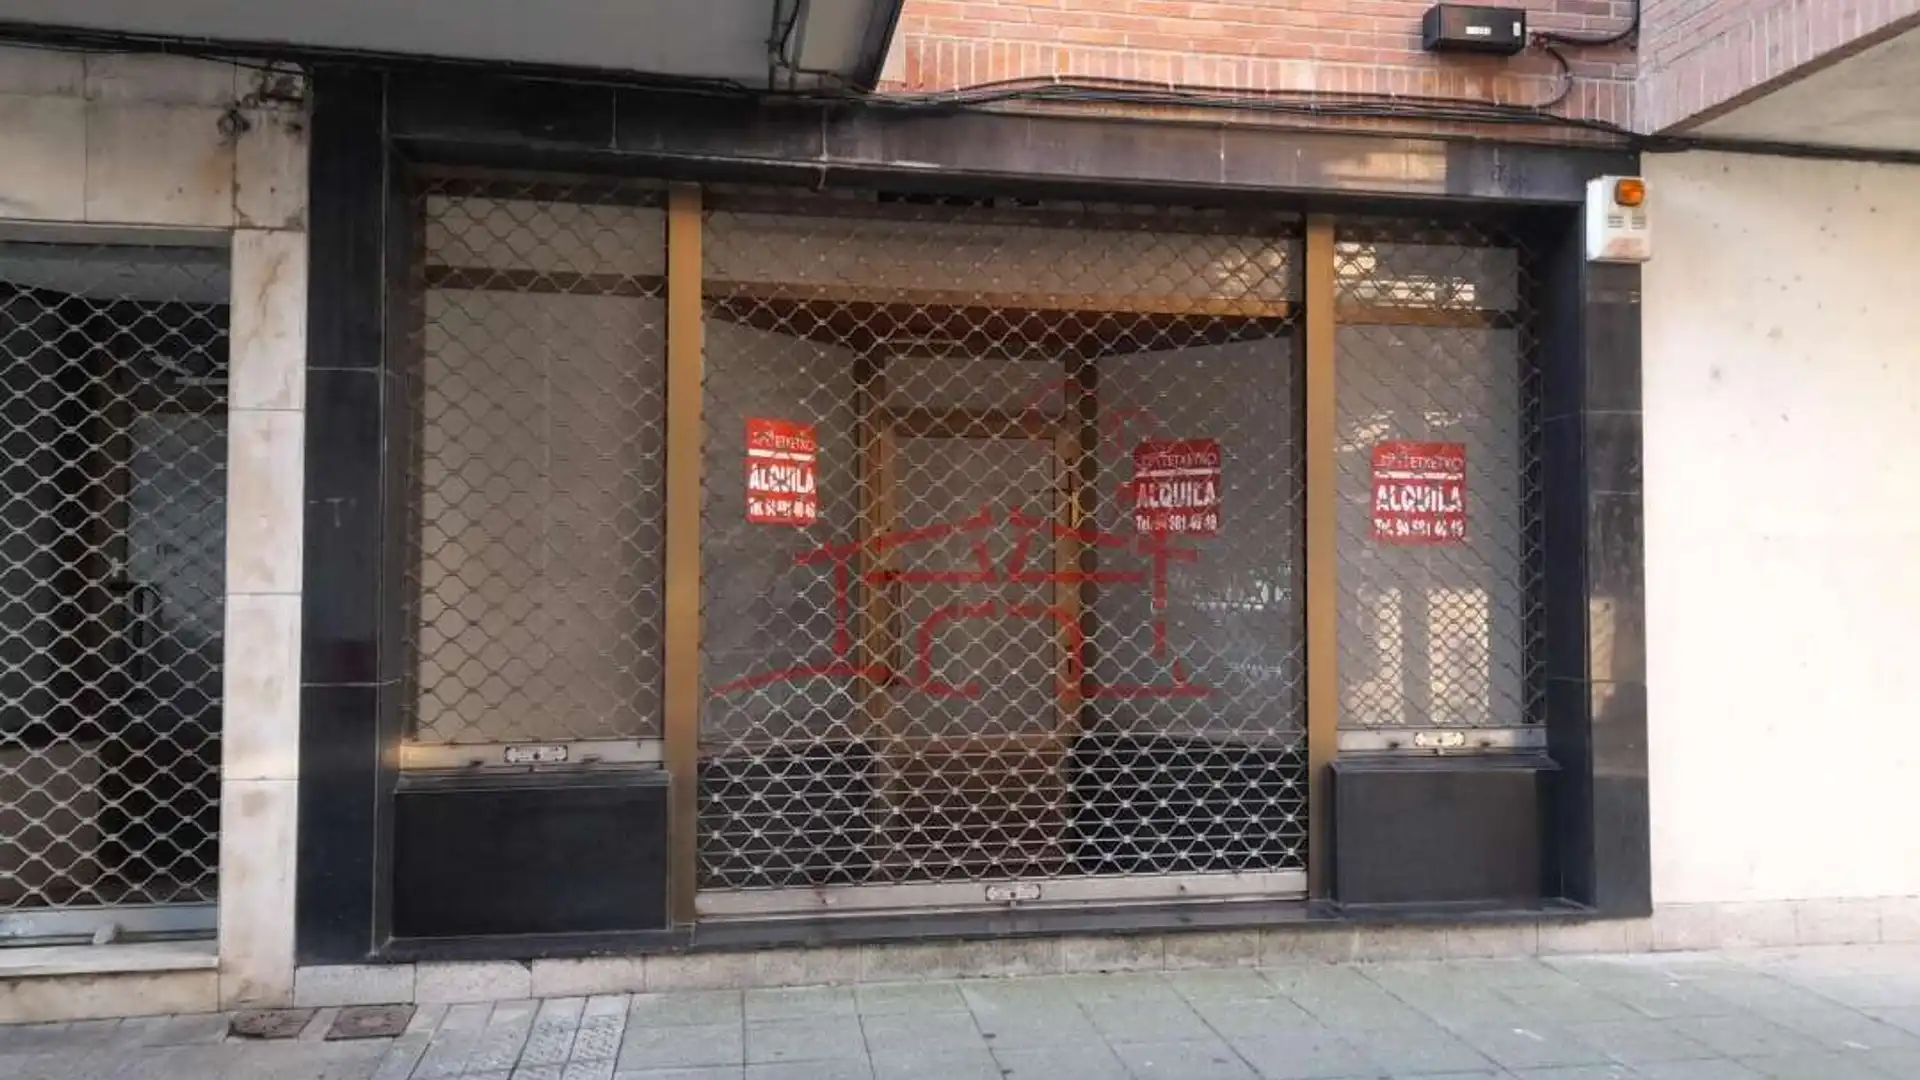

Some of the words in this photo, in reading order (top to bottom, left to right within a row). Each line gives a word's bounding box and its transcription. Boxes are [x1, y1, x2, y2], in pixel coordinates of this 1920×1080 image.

[749, 463, 816, 494] ALQUILA
[1137, 480, 1216, 508] ALQUILA
[1376, 484, 1463, 512] ALQUILA
